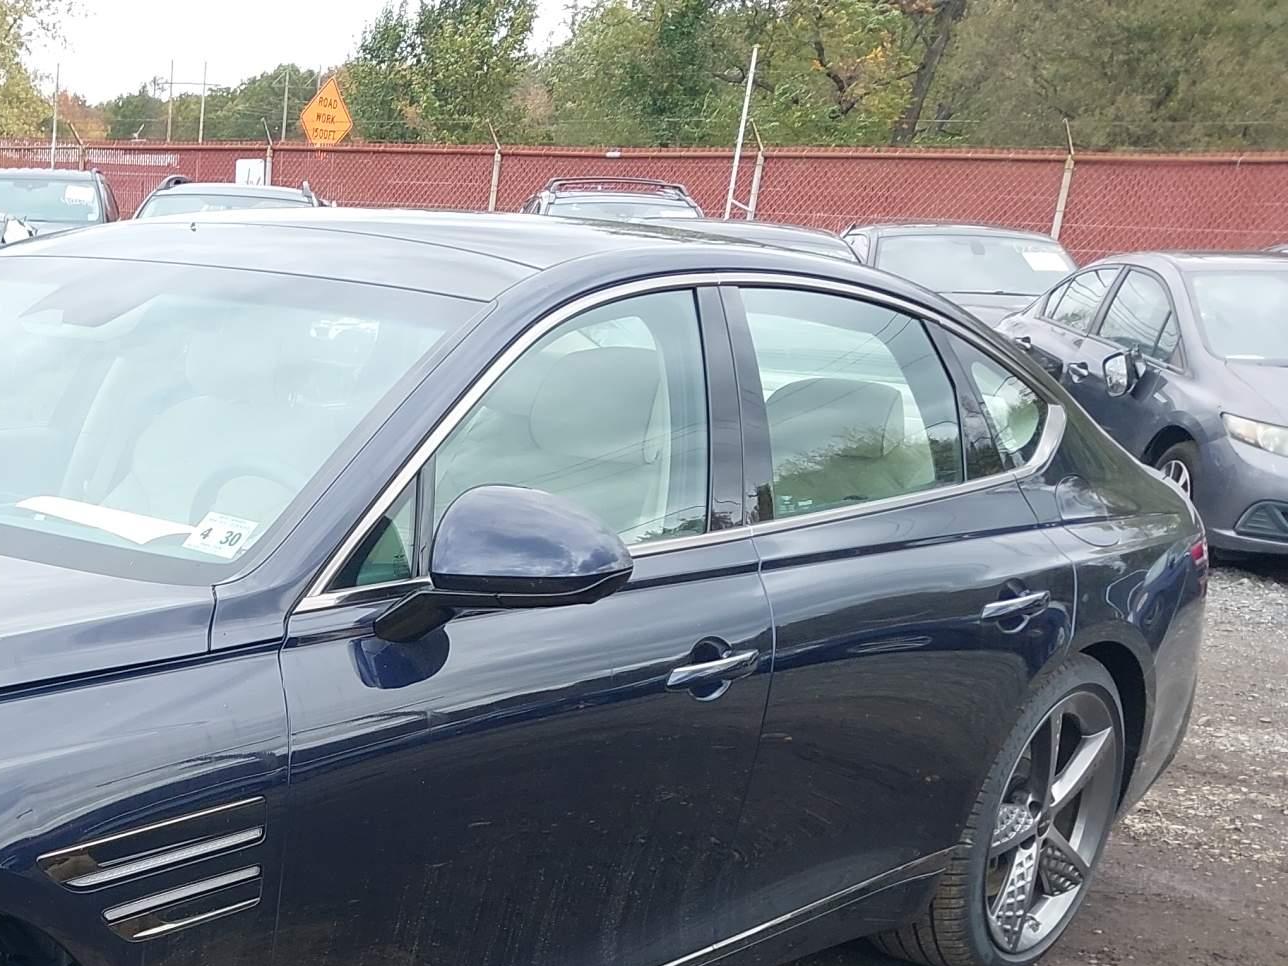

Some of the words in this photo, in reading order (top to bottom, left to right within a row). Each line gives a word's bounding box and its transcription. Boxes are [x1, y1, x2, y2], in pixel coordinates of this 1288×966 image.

[319, 97, 337, 109] ROAD
[317, 113, 336, 124] WORK
[199, 527, 213, 540] 4
[219, 531, 242, 546] 30
